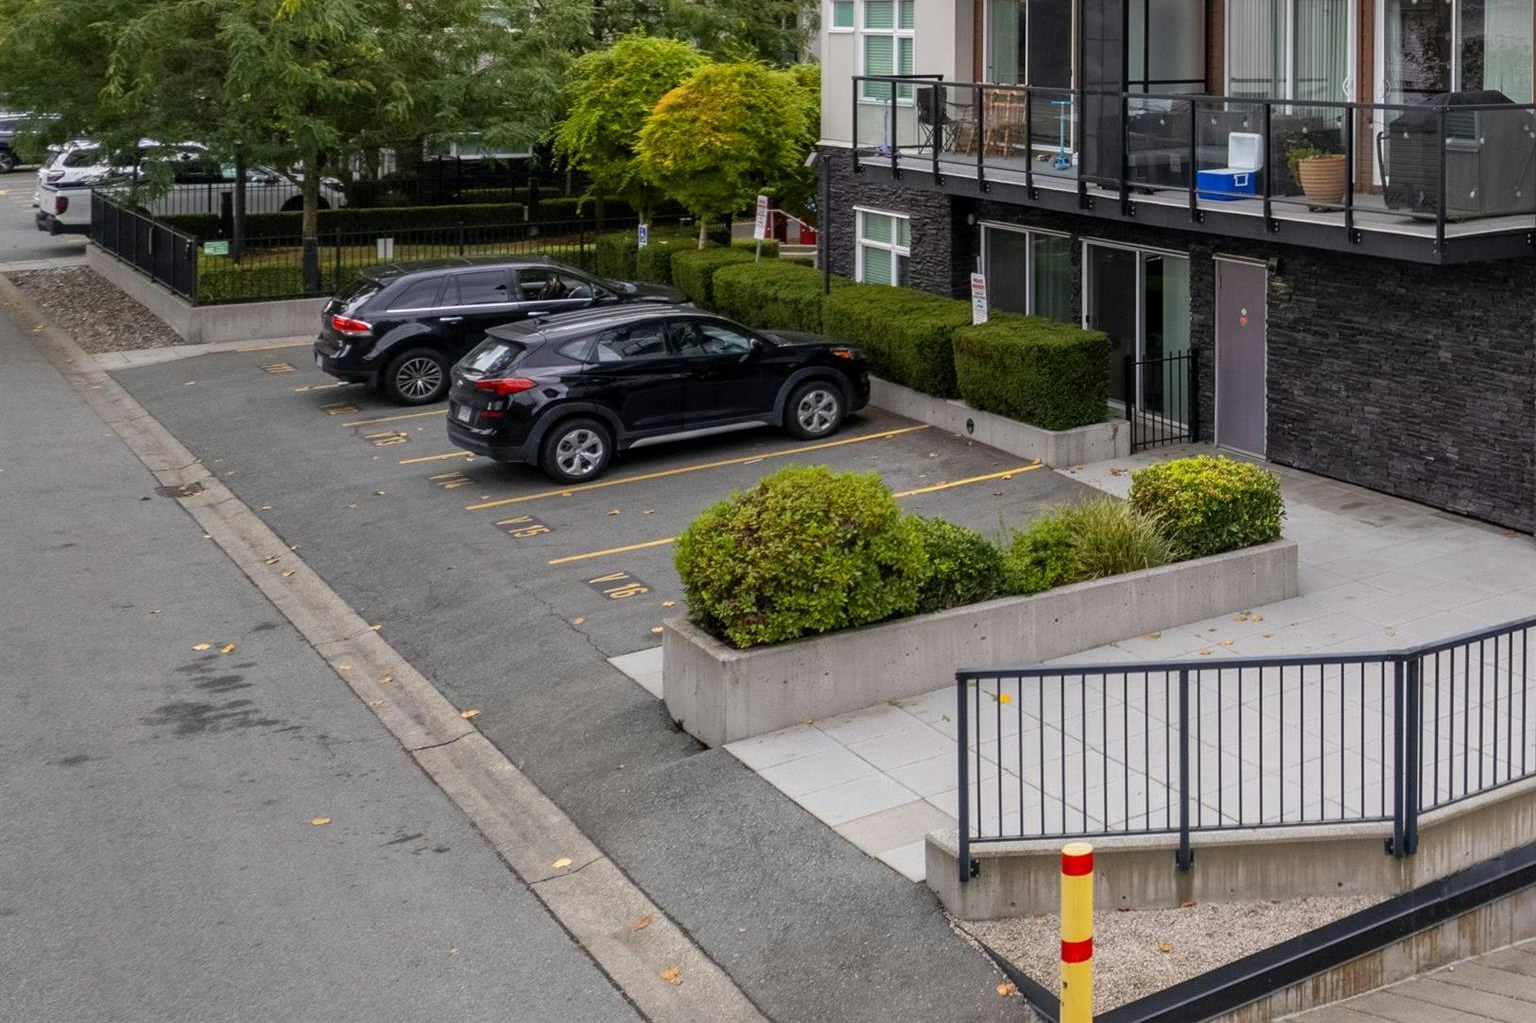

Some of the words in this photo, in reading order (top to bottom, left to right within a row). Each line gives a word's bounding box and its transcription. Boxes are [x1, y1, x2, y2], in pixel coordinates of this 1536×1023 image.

[496, 515, 533, 526] V
[508, 524, 550, 538] 15
[588, 571, 630, 584] V
[603, 583, 648, 599] 16
